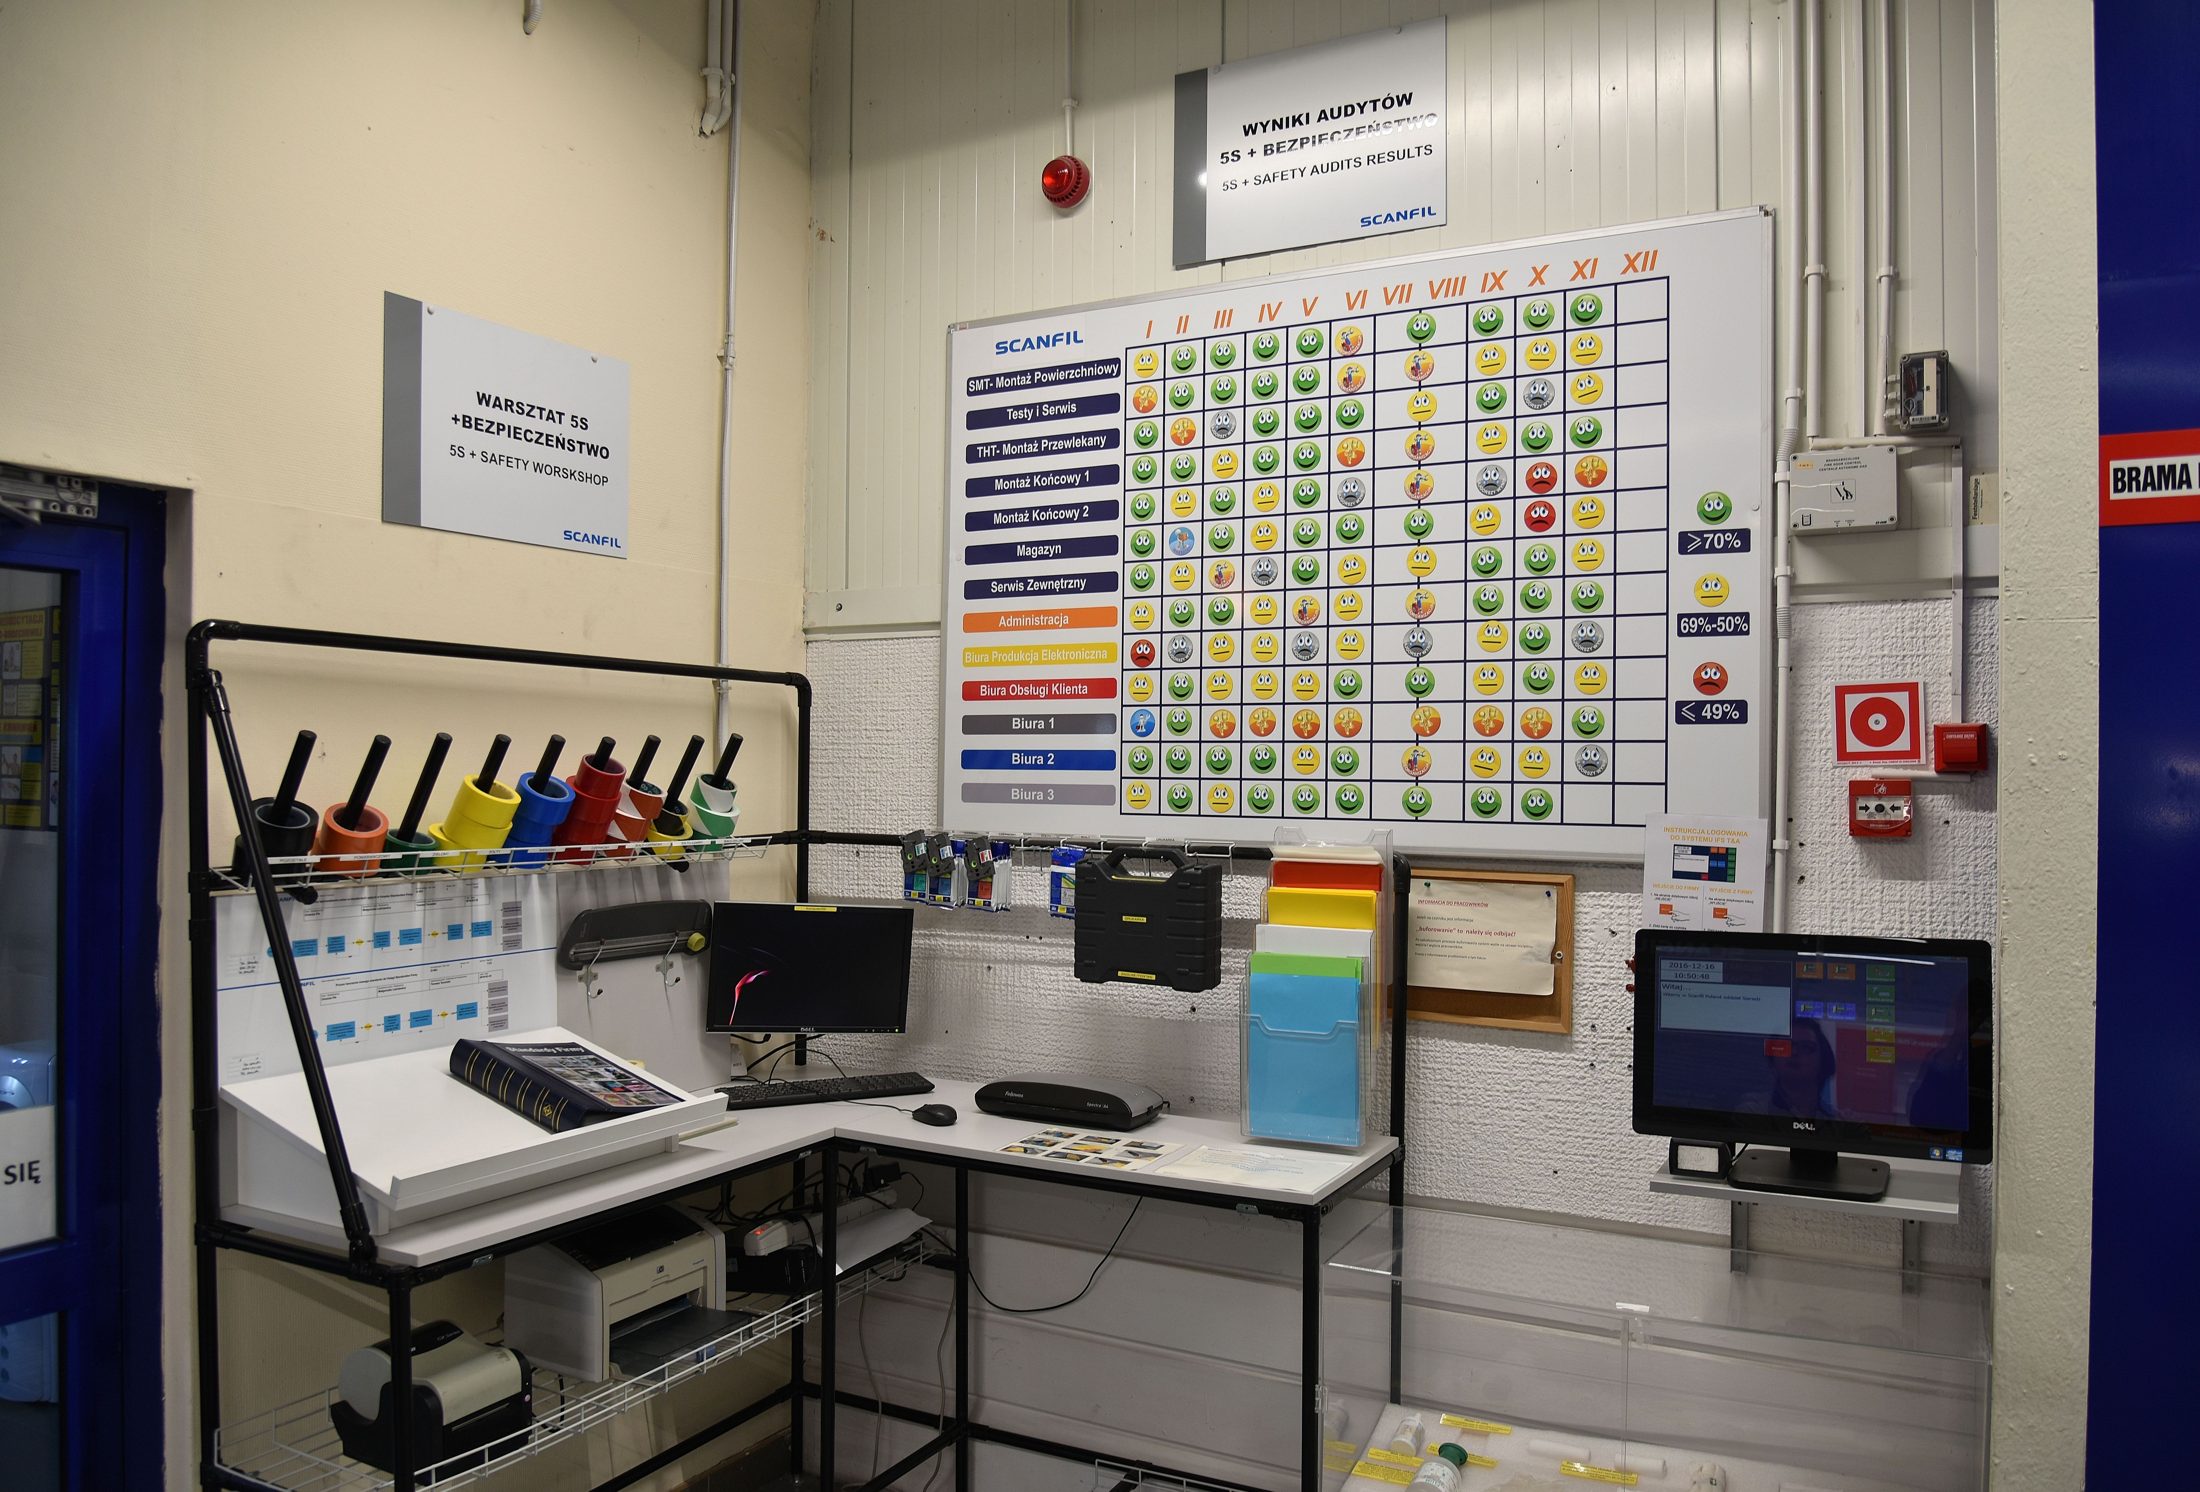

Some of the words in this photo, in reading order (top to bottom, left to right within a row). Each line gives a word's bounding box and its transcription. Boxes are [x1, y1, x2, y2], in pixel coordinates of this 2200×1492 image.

[1242, 111, 1310, 137] WYNIKI
[1317, 92, 1413, 123] AUDYTÓW
[1220, 149, 1241, 164] 5S
[1247, 148, 1256, 158] +
[1263, 112, 1439, 157] BEZPIECZEŃSTWO
[1222, 177, 1238, 192] 5S
[1242, 178, 1249, 187] +
[1253, 167, 1307, 187] SAFETY
[1310, 156, 1362, 176] AUDITS
[1366, 144, 1433, 166] RESULTS
[1360, 205, 1437, 227] SCANFIL
[1146, 320, 1153, 339] I
[1176, 315, 1190, 335] II
[1213, 309, 1234, 329] III
[1258, 301, 1282, 323] IV
[1301, 296, 1319, 318] V
[1345, 289, 1368, 312] VI
[1382, 283, 1413, 306] VII
[1428, 276, 1466, 300] VIII
[1480, 270, 1508, 293] IX
[1528, 264, 1550, 287] X
[1569, 257, 1599, 281] XI
[1620, 249, 1658, 276] XII
[995, 330, 1084, 356] SCANFIL
[968, 379, 993, 392] SMT-
[995, 374, 1032, 389] Montaż
[1034, 362, 1119, 385] Powierzchniowy
[476, 391, 566, 425] WARSZTAT
[570, 414, 590, 431] 5S
[1007, 406, 1034, 421] Testy
[1036, 404, 1040, 416] i
[1042, 401, 1077, 415] Serwis
[451, 413, 610, 460] +BEZPIECZEŃSTWO
[977, 445, 1000, 458] THT-
[1002, 440, 1038, 456] Montaż
[1041, 434, 1107, 453] Przewlekany
[450, 444, 466, 459] 5S
[470, 450, 477, 459] +
[480, 450, 530, 472] SAFETY
[532, 461, 609, 487] WORSKSHOP
[994, 475, 1031, 491] Montaż
[1033, 471, 1081, 490] Końcowy
[1084, 470, 1090, 482] 1
[2113, 463, 2192, 494] BRAMA
[993, 510, 1030, 525] Montaż
[1032, 507, 1080, 524] Końcowy
[1082, 505, 1089, 517] 2
[563, 530, 621, 549] SCANFIL
[1016, 543, 1062, 560] Magazyn
[990, 580, 1024, 594] Serwis
[1026, 578, 1087, 593] Zewnętrzny
[998, 613, 1069, 628] Administracja
[1680, 615, 1749, 634] 69%-50%
[965, 650, 990, 663] Biura
[991, 649, 1039, 664] Produkcja
[1041, 648, 1108, 662] Elektroniczna
[980, 684, 1007, 697] Biura
[1009, 683, 1049, 698] Obsługi
[1051, 682, 1088, 696] Klienta
[1701, 703, 1740, 720] 49%
[1012, 717, 1045, 730] Biura
[1049, 716, 1055, 729] 1
[1011, 753, 1044, 765] Biura
[1047, 753, 1055, 765] 2
[1011, 788, 1044, 801] Biura
[1047, 788, 1055, 801] 3
[1664, 826, 1706, 835] INSTRUKCJA
[1707, 829, 1748, 838] LOGOWANIA
[1682, 835, 1713, 843] SYSTEMU
[1465, 928, 1483, 936] należy
[1668, 962, 1715, 970] 2016-12-16
[1674, 972, 1710, 980] 10:50:48
[1792, 1122, 1816, 1131] DELL
[4, 1160, 41, 1185] SIĘ
